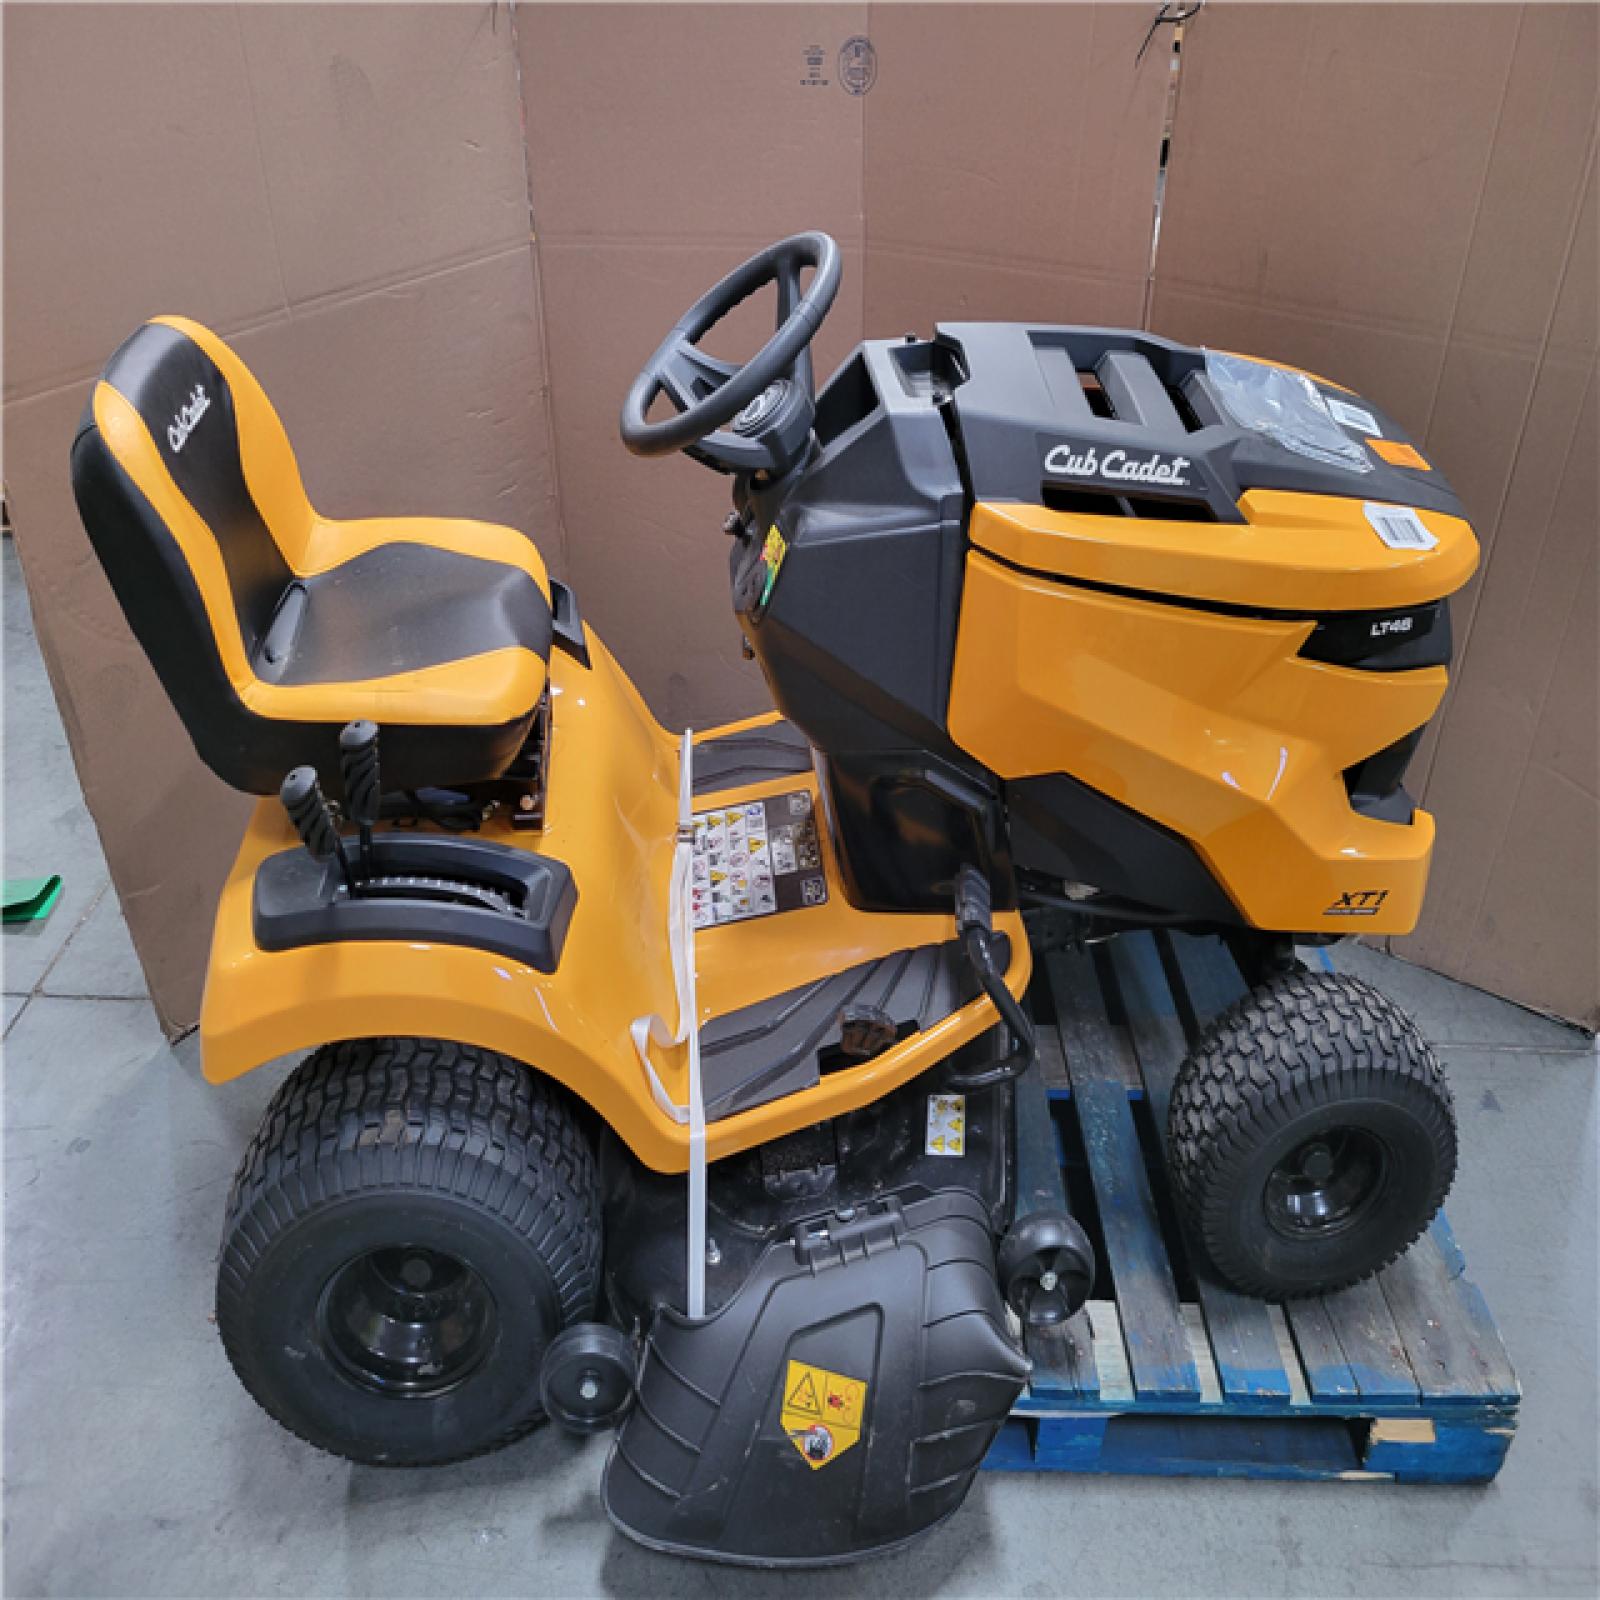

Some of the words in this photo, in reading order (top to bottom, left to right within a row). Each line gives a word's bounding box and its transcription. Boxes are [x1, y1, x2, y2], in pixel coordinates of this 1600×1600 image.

[1044, 444, 1098, 475] Cub
[1099, 449, 1191, 485] Cadet
[1332, 889, 1389, 906] XT1
